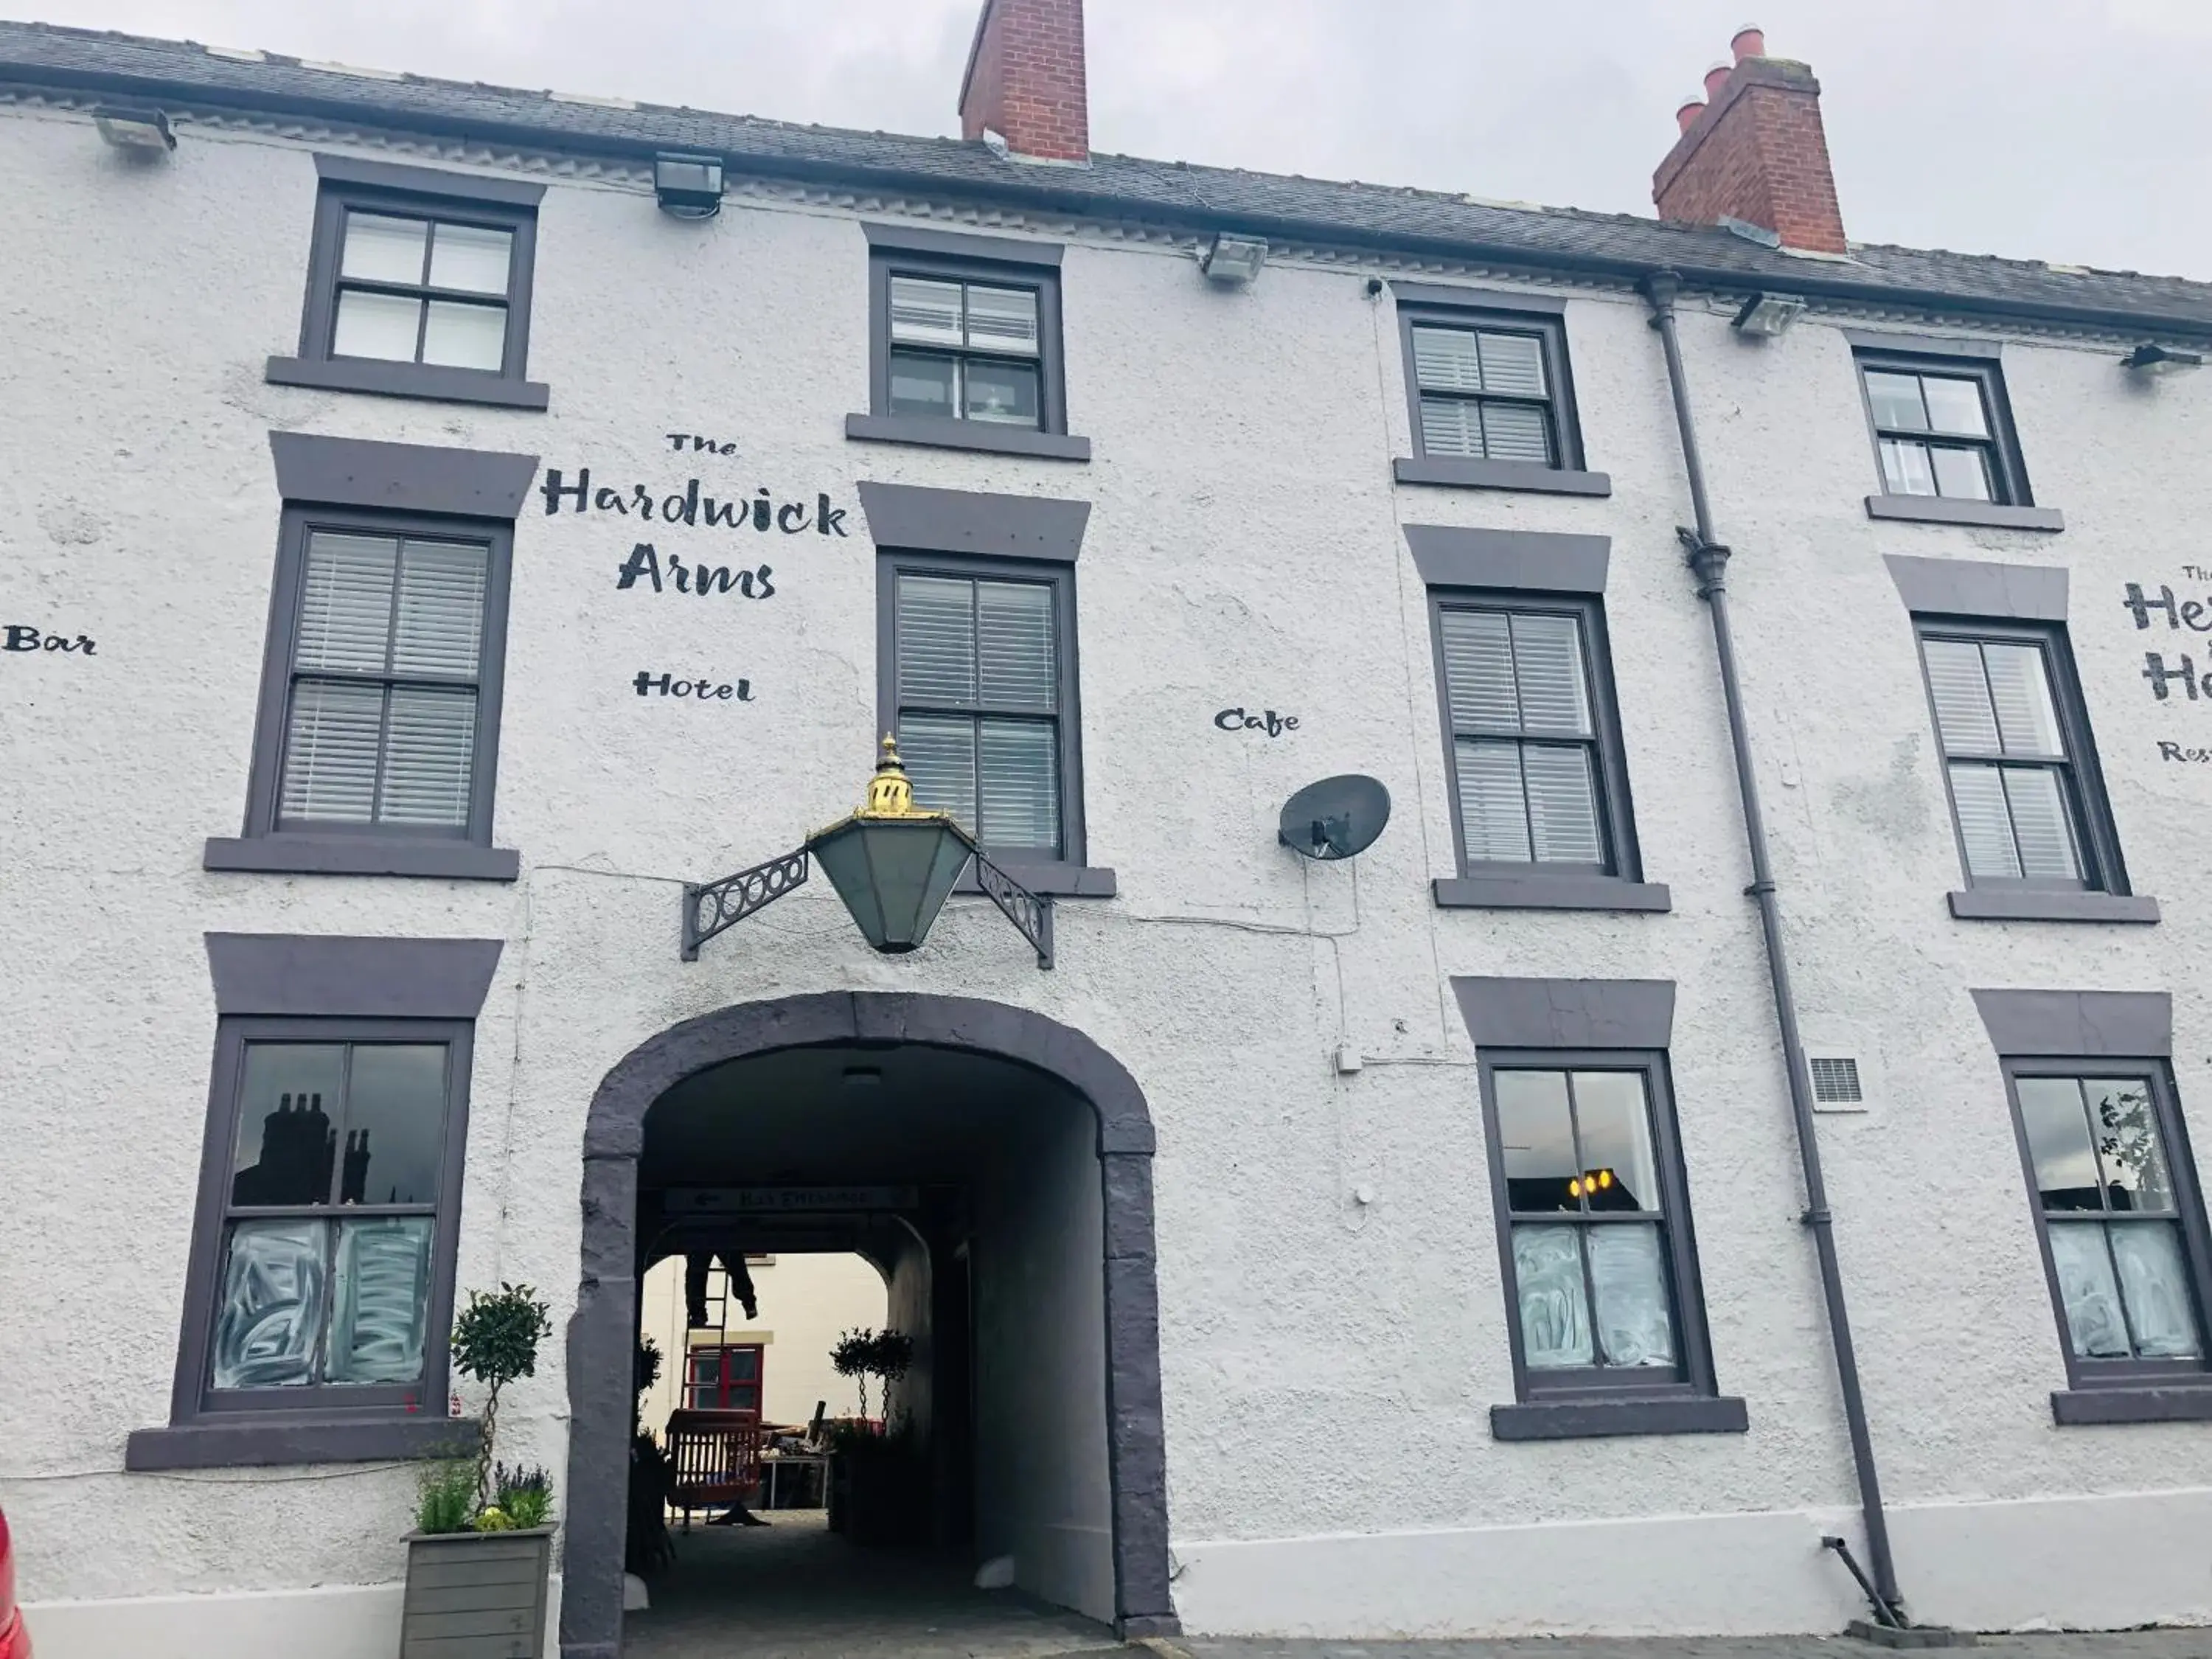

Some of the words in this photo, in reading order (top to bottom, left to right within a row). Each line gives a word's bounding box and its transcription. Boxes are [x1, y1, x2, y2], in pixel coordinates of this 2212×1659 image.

[666, 434, 737, 456] The
[540, 467, 849, 538] Hardwick
[616, 543, 776, 599] Arms
[2182, 566, 2212, 581] Th
[2123, 582, 2212, 632] He
[1, 625, 97, 655] Bar
[633, 671, 756, 701] Hotel
[1214, 707, 1300, 738] Cafe
[2157, 741, 2212, 763] Res
